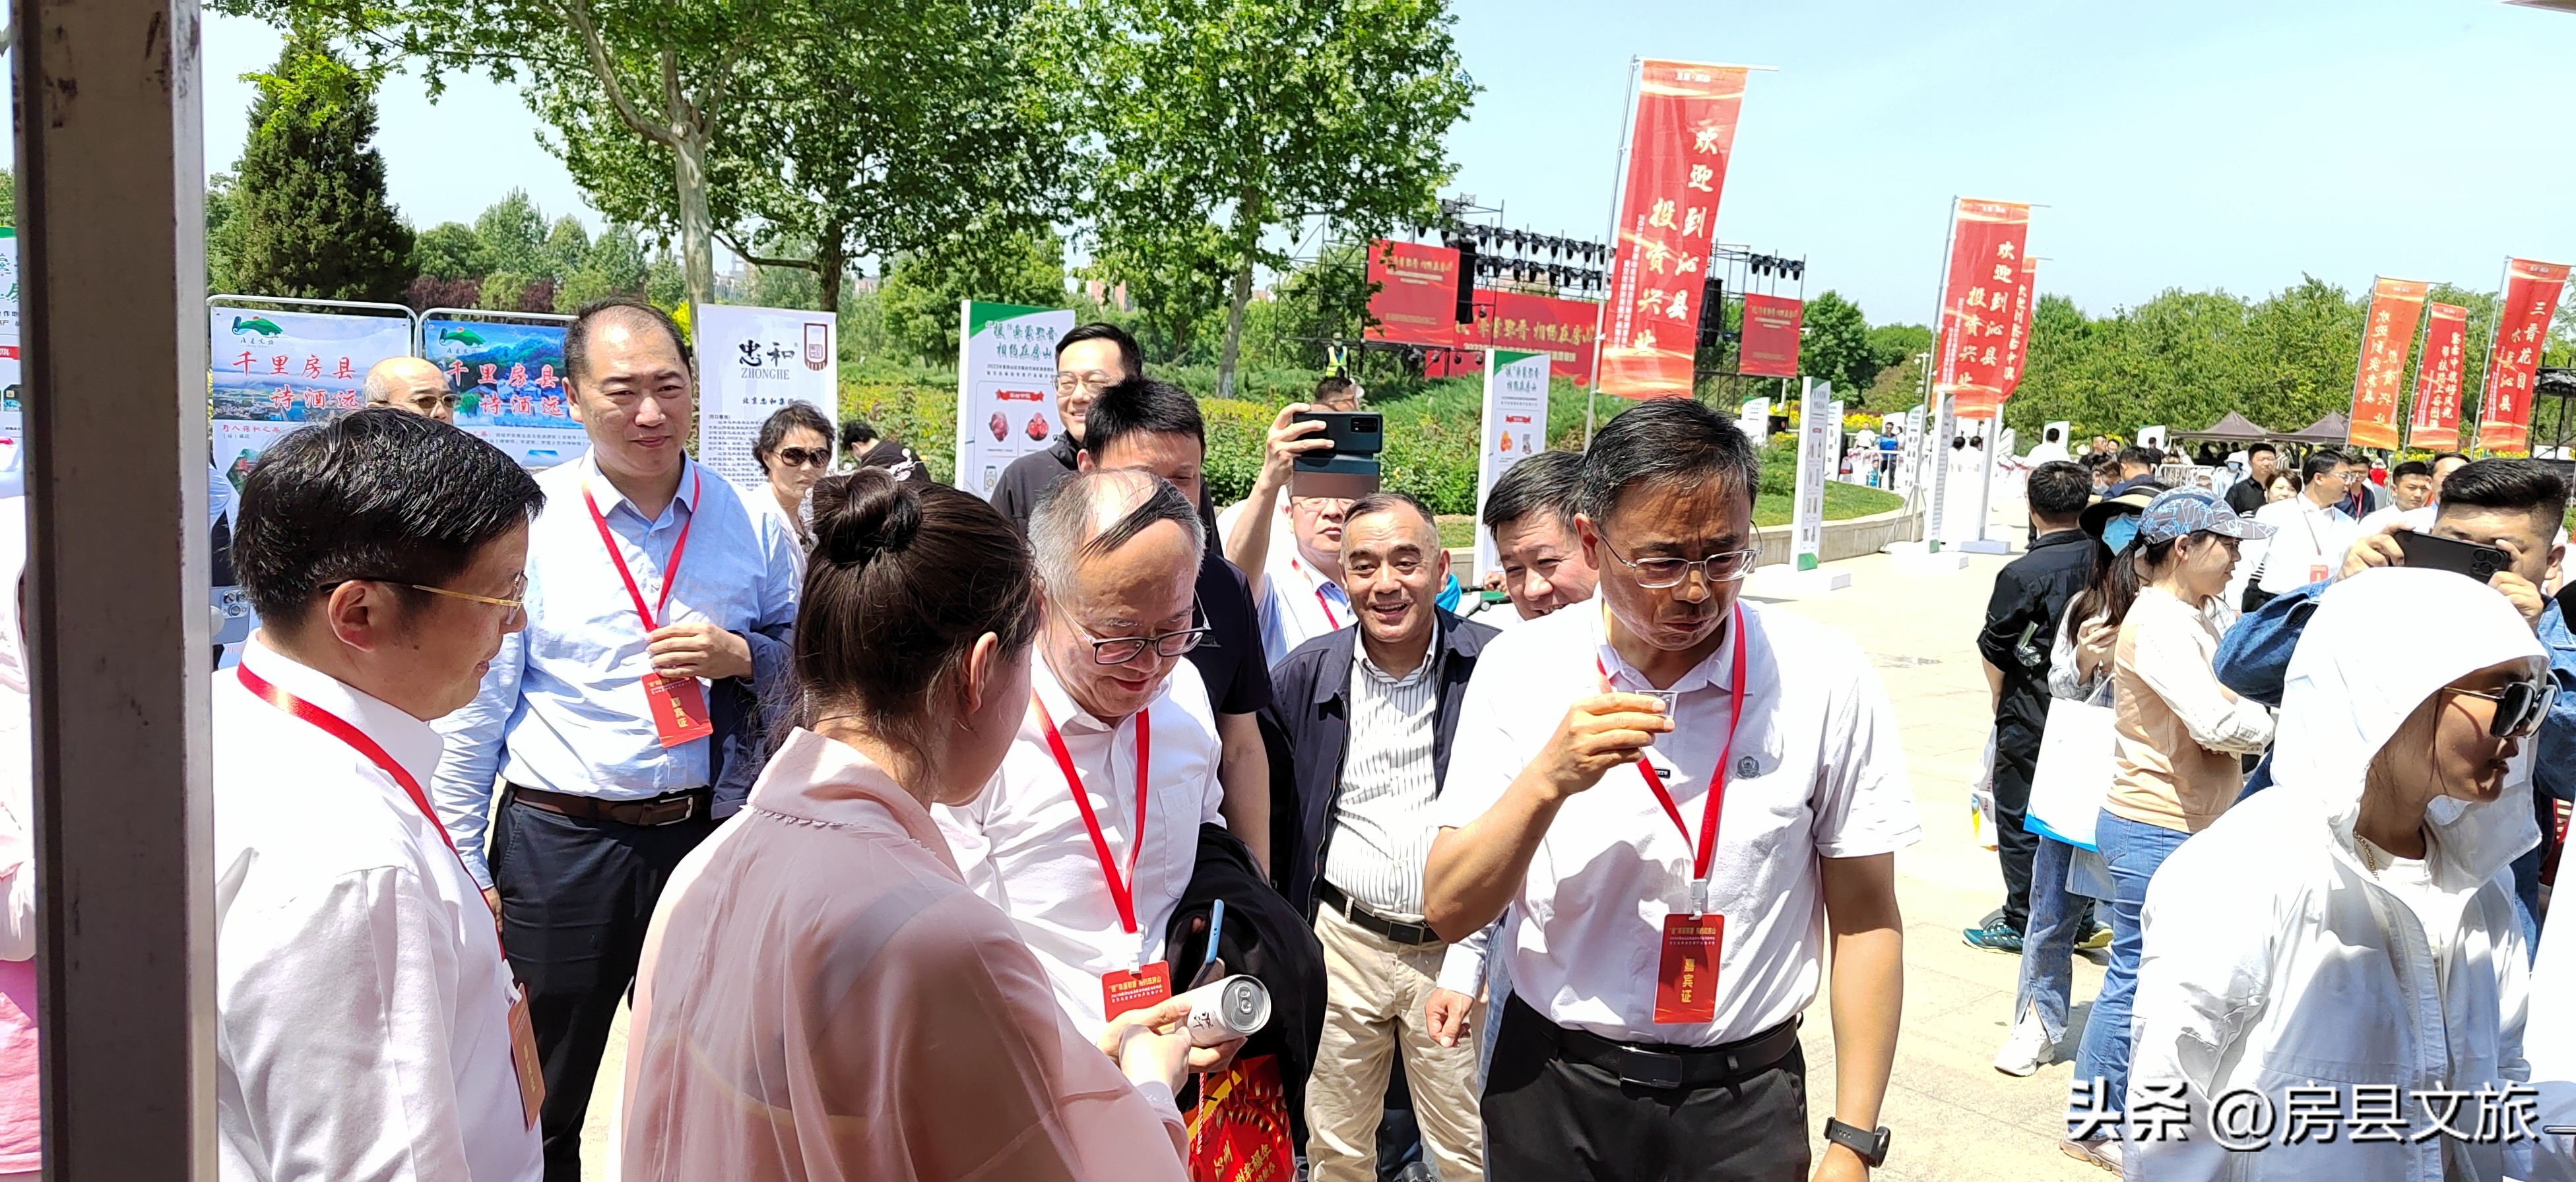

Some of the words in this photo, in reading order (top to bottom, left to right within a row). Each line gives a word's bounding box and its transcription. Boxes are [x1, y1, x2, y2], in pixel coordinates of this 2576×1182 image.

[1665, 126, 1718, 321] 欢迎到沁县
[1634, 197, 1678, 354] 投资兴业
[1980, 241, 2015, 367] 欢迎到沁县
[996, 342, 1052, 361] 相约在房山
[1957, 286, 1987, 388] 投资兴业
[232, 350, 357, 380] 千里房县
[738, 339, 796, 367] 忠和
[445, 359, 560, 388] 千里房县
[740, 367, 790, 380] ZHONGHE
[269, 383, 360, 412] 诗酒远
[478, 391, 565, 417] 诗酒远
[1681, 958, 1696, 1003] 嘉宾证
